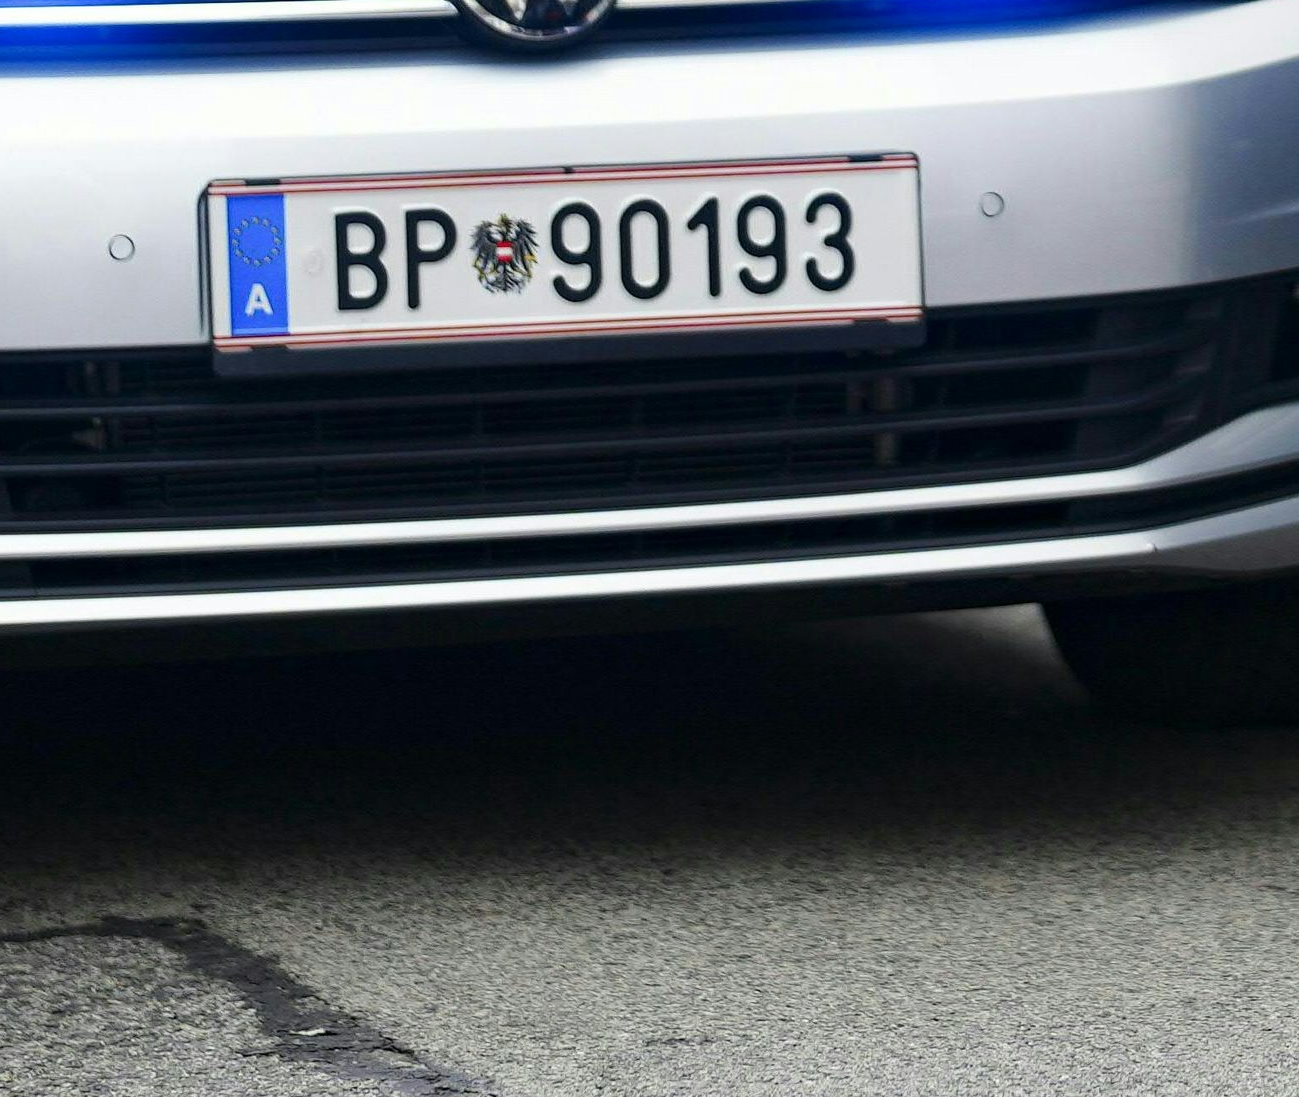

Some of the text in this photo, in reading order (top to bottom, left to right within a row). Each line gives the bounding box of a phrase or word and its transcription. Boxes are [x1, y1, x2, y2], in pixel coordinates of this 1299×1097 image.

[334, 192, 855, 311] BP 90193
[244, 283, 274, 316] A
